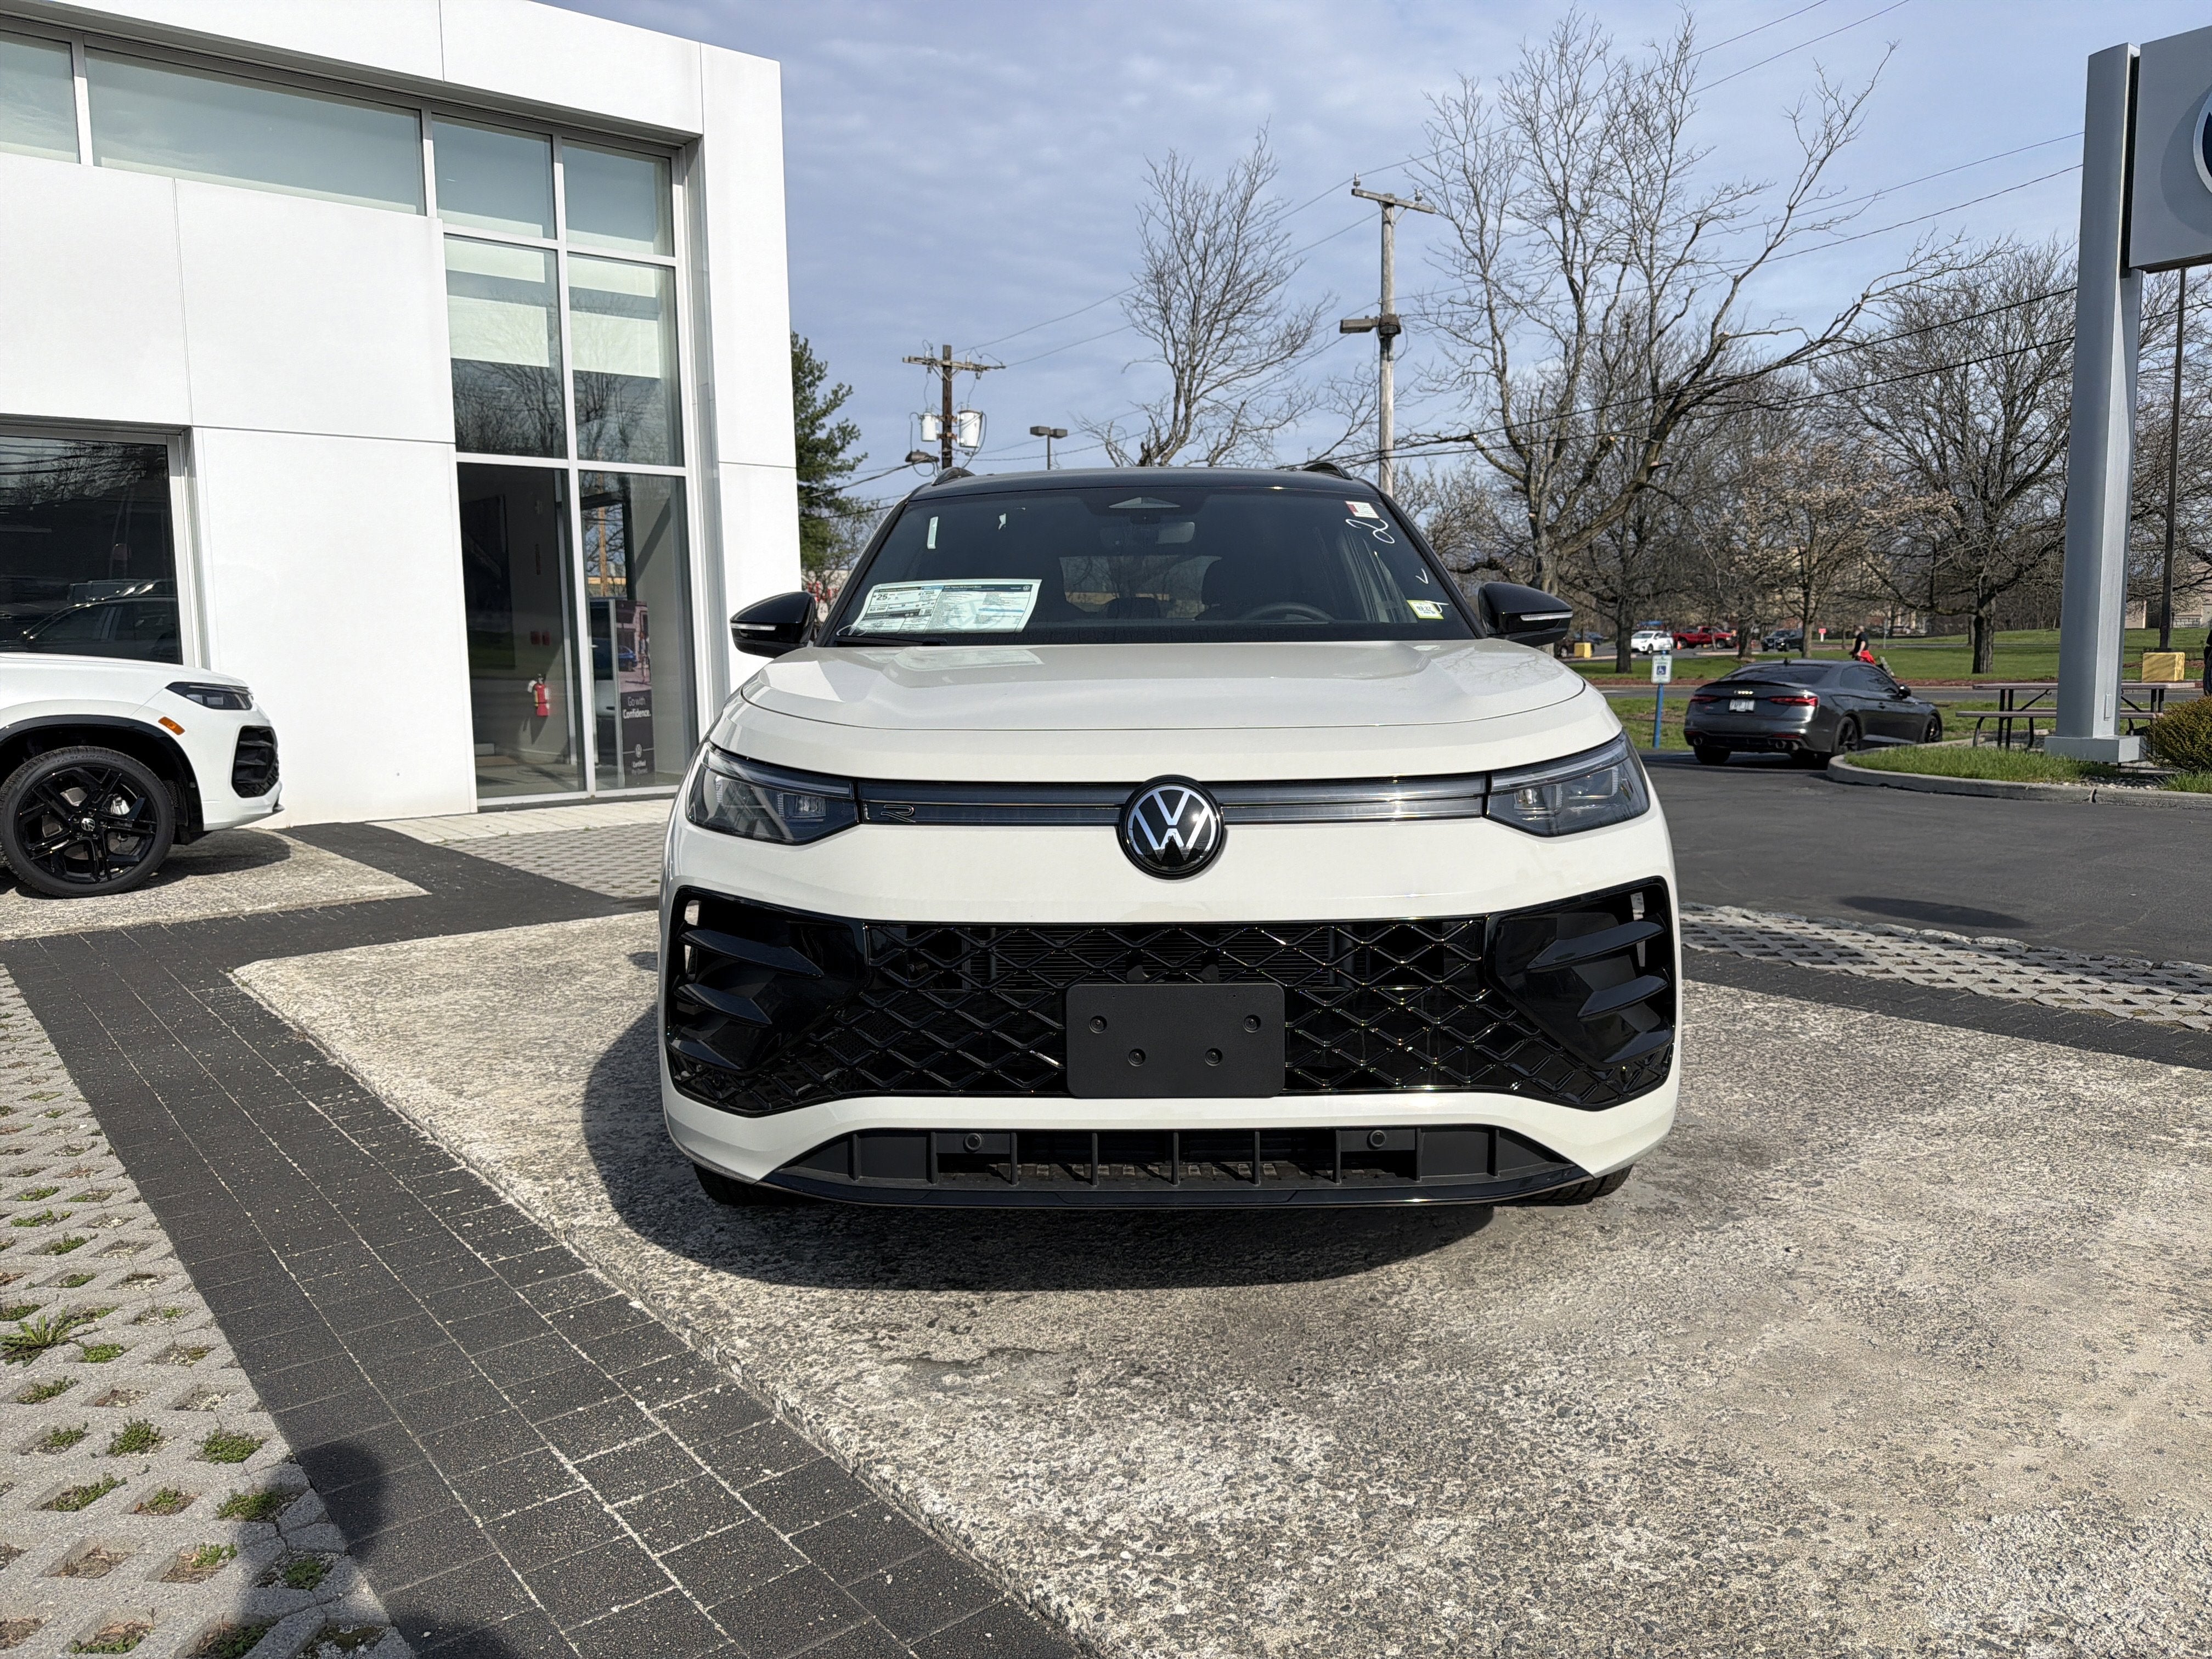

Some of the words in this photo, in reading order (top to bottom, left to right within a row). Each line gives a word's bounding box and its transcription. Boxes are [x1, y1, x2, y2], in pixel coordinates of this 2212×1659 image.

[628, 696, 635, 707] Go
[635, 696, 646, 706] with
[623, 708, 651, 719] Confidence.
